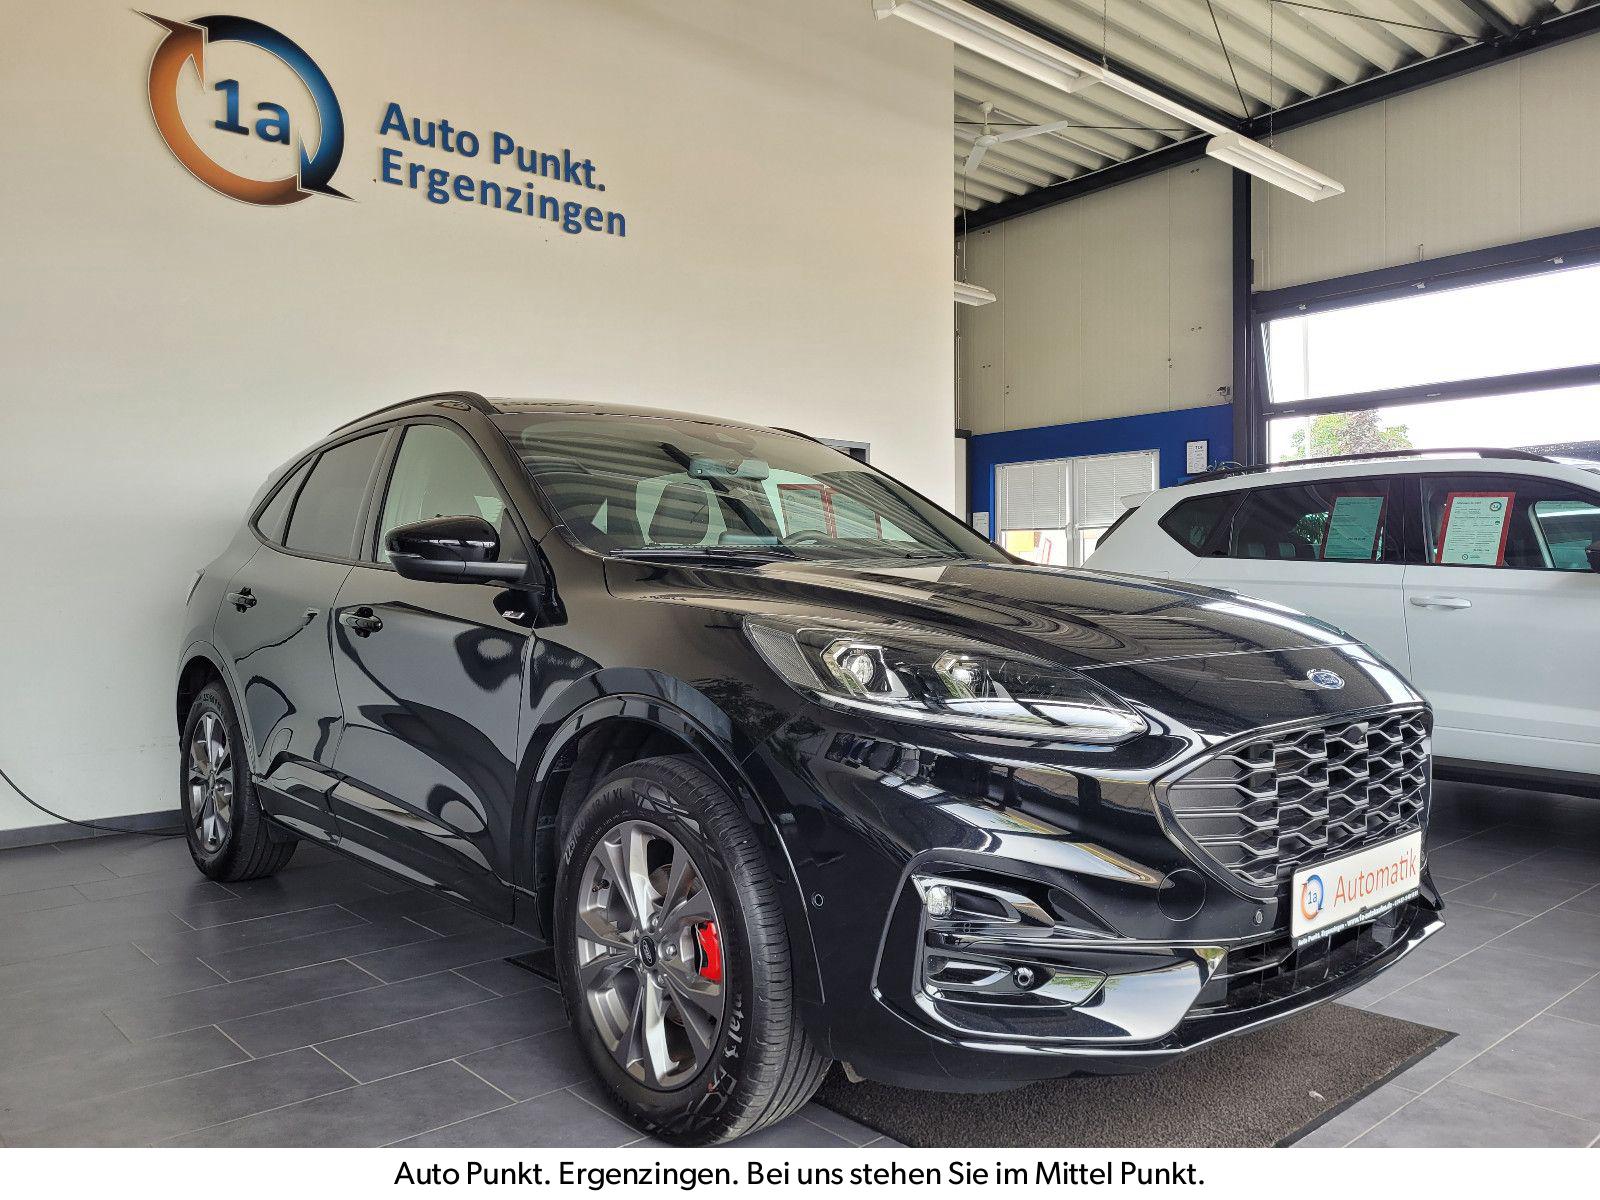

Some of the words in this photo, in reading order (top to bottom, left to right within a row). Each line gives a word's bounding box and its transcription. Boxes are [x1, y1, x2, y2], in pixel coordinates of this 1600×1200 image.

[214, 78, 291, 146] 1a
[379, 101, 480, 158] Auto
[492, 131, 607, 193] Punkt.
[380, 147, 628, 238] Ergenzingen
[1307, 890, 1318, 905] 1a
[1333, 848, 1417, 908] Automatik
